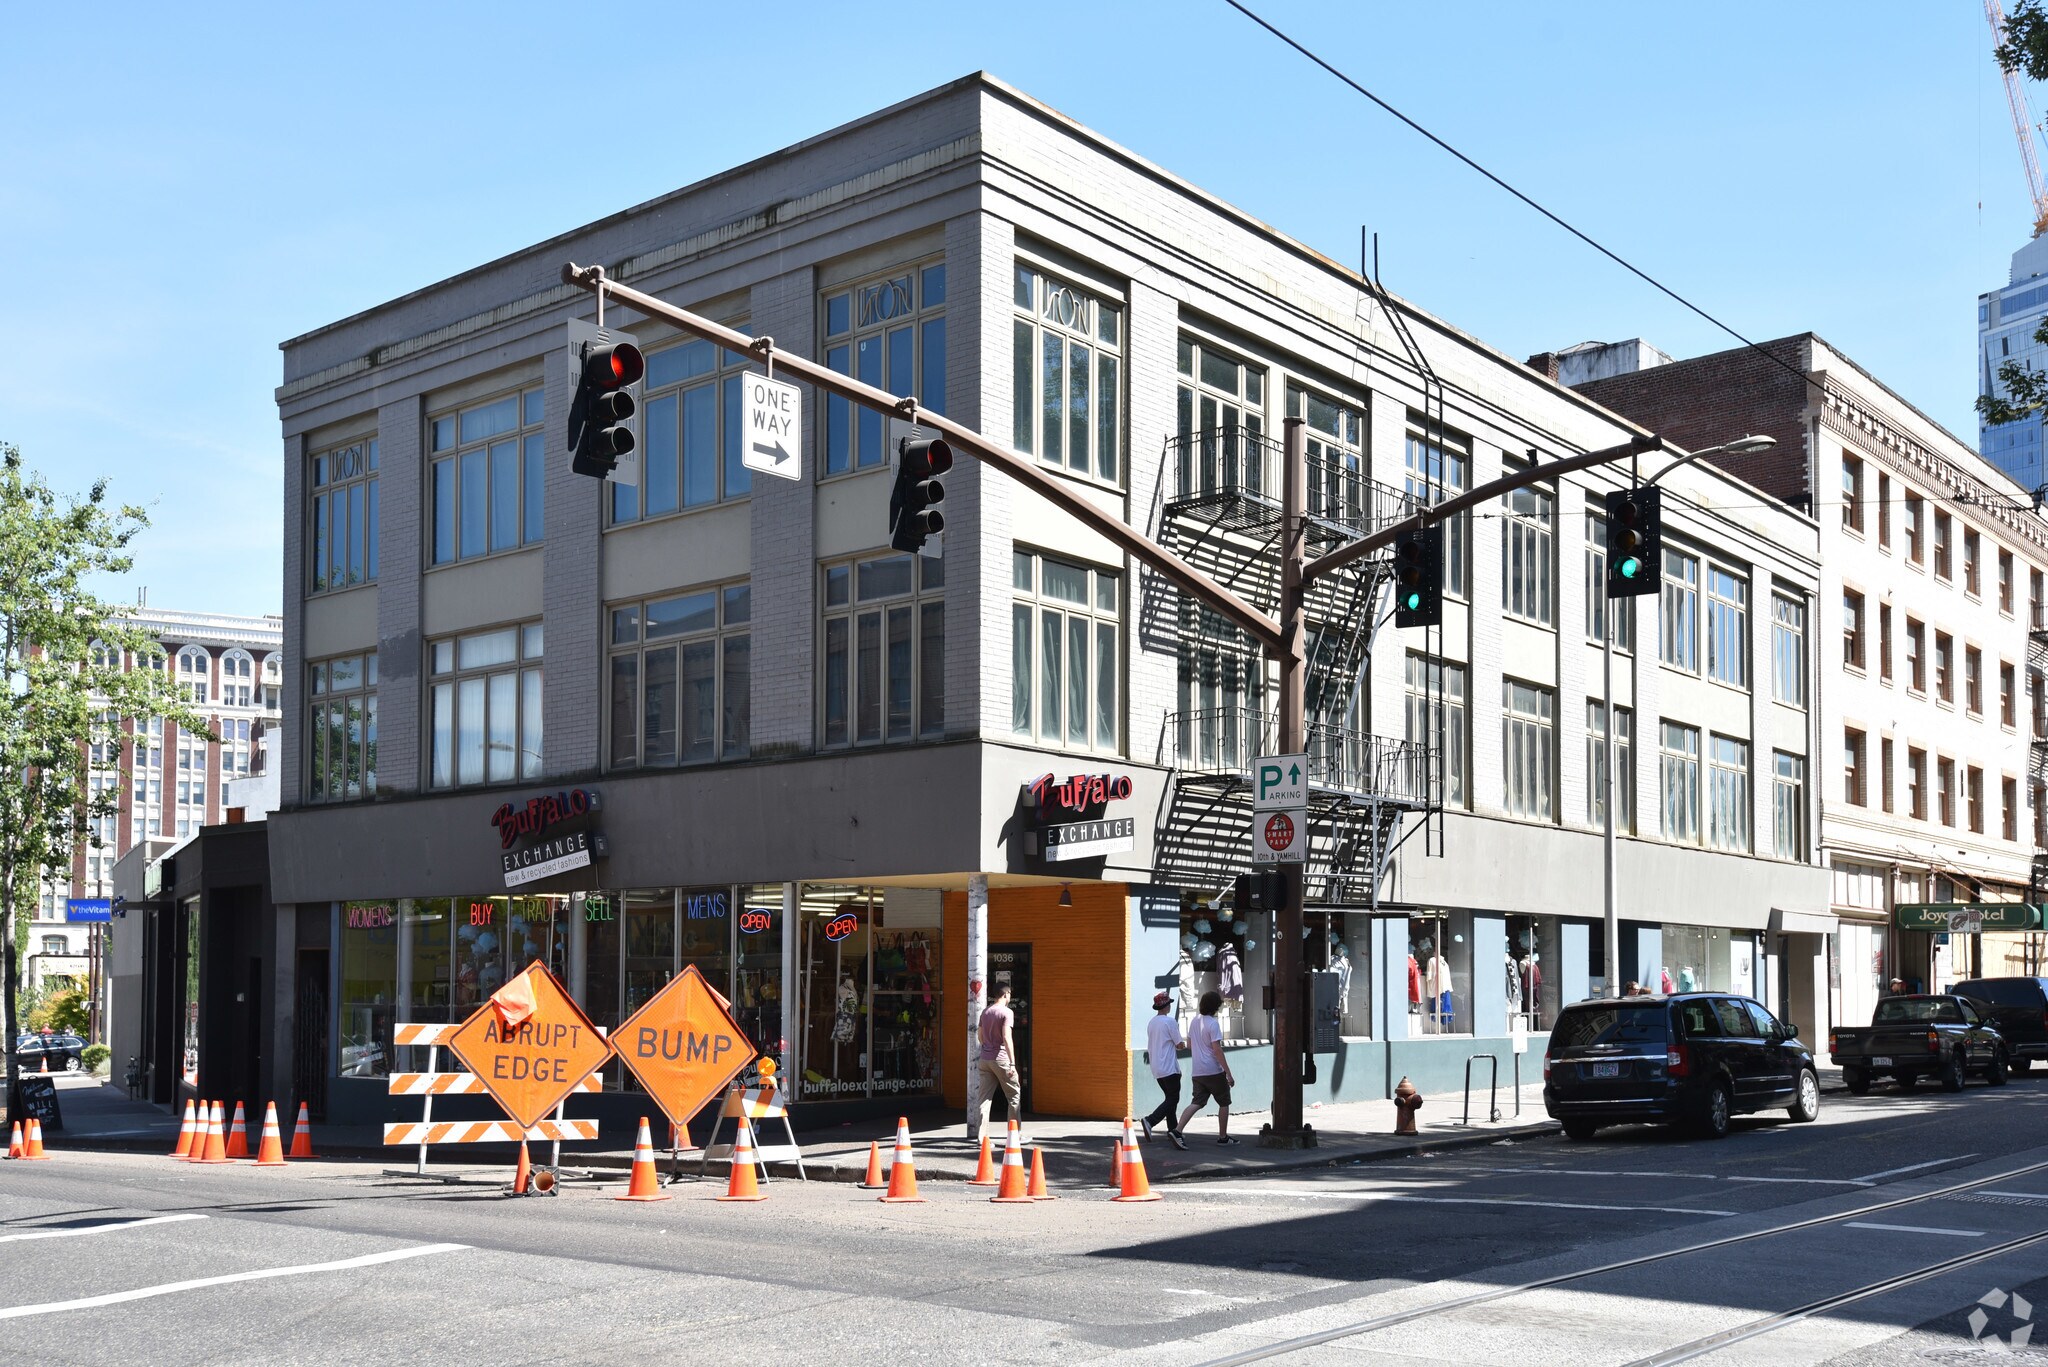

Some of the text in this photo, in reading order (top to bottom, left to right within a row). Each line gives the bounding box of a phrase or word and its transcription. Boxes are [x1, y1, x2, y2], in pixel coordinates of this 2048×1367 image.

[754, 384, 790, 413] ONE
[753, 408, 791, 436] WAY
[1047, 820, 1132, 845] EXCHANGE
[1269, 838, 1289, 846] PARK
[503, 833, 586, 871] EXCHANGE
[1276, 851, 1301, 860] YAMHILL
[506, 853, 589, 885] new & recycled fashions
[348, 906, 392, 928] WOMENS
[470, 903, 493, 927] BUY
[521, 899, 559, 923] TRADE
[584, 898, 615, 922] SELL
[687, 893, 725, 920] MENS
[740, 913, 771, 929] OPEN
[826, 918, 858, 937] OPEN
[993, 953, 1014, 963] 1036
[484, 1019, 582, 1049] ABRUPT
[637, 1026, 732, 1065] BUMP
[493, 1055, 569, 1083] EDGE
[803, 1077, 935, 1094] buffaloexchange.com
